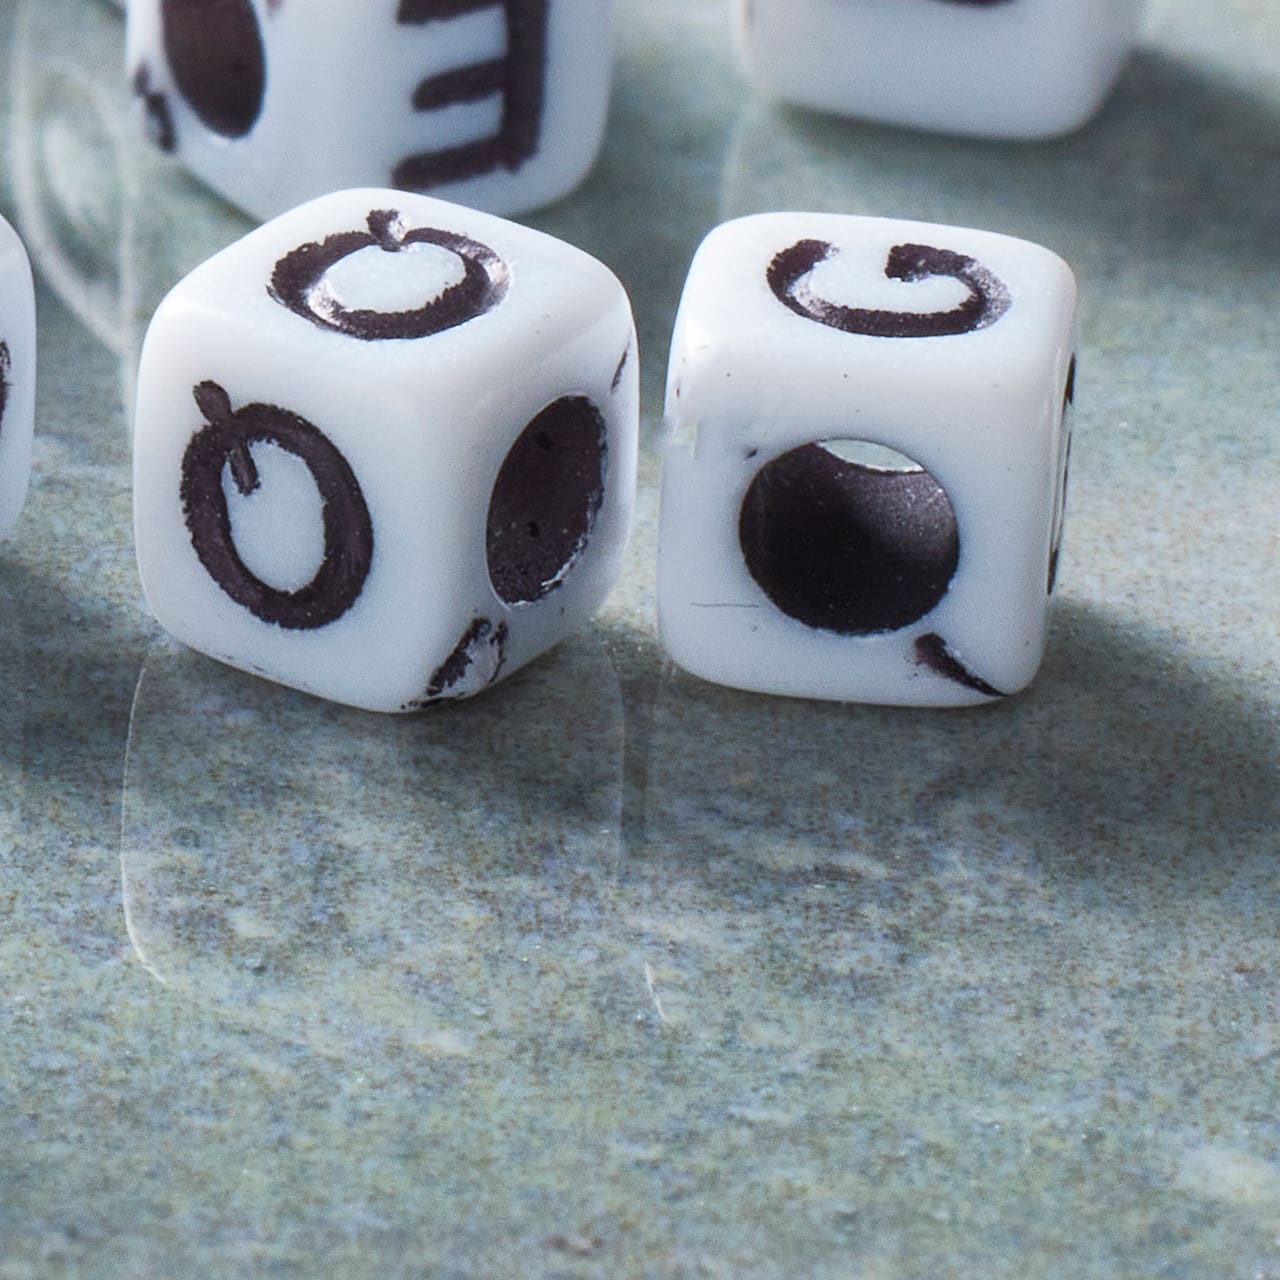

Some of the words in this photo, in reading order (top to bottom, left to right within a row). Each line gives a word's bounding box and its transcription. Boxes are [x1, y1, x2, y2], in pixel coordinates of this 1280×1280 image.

[266, 207, 512, 342] Q
[766, 238, 1012, 340] G
[180, 379, 376, 632] Q
